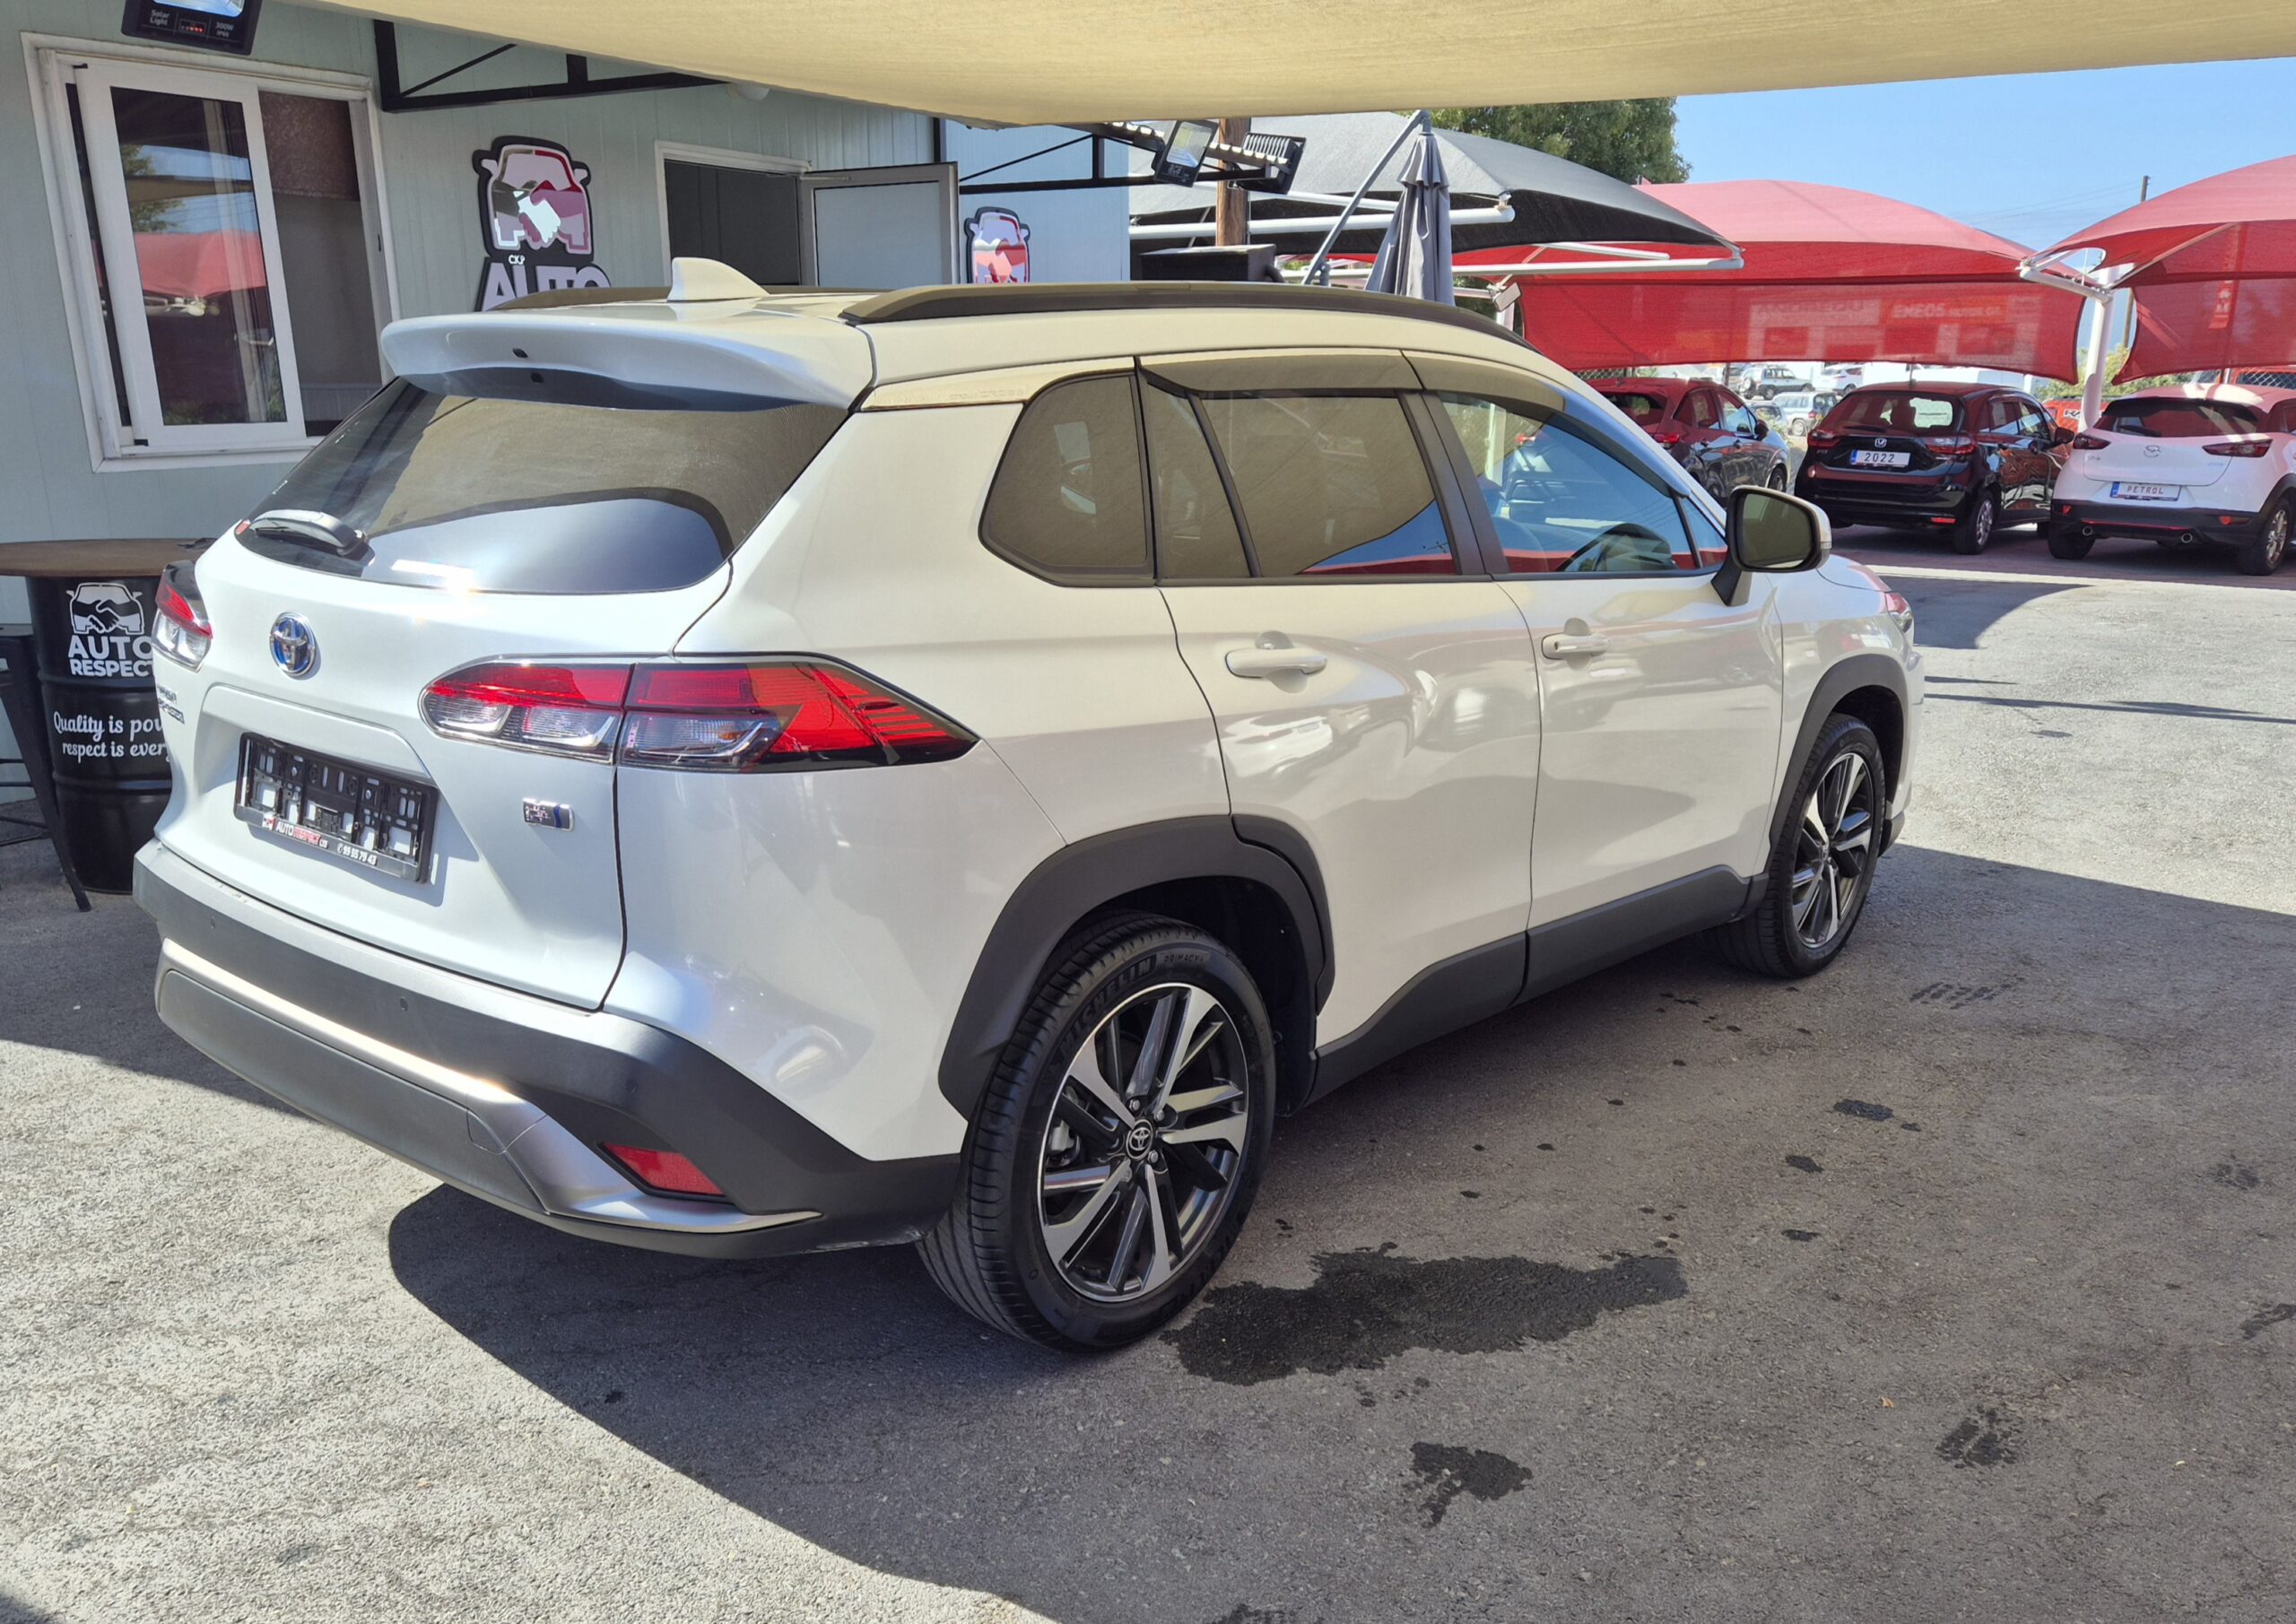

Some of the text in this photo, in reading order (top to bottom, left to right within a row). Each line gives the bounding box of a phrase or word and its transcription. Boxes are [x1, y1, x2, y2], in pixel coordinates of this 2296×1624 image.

[150, 10, 170, 19] Solar
[149, 17, 169, 26] Light
[1864, 452, 1895, 464] 2022
[2126, 485, 2164, 495] PETROL
[67, 635, 152, 660] AUTO
[54, 711, 105, 743] Quality
[109, 716, 124, 734] is
[62, 743, 108, 764] respect
[110, 742, 125, 757] is
